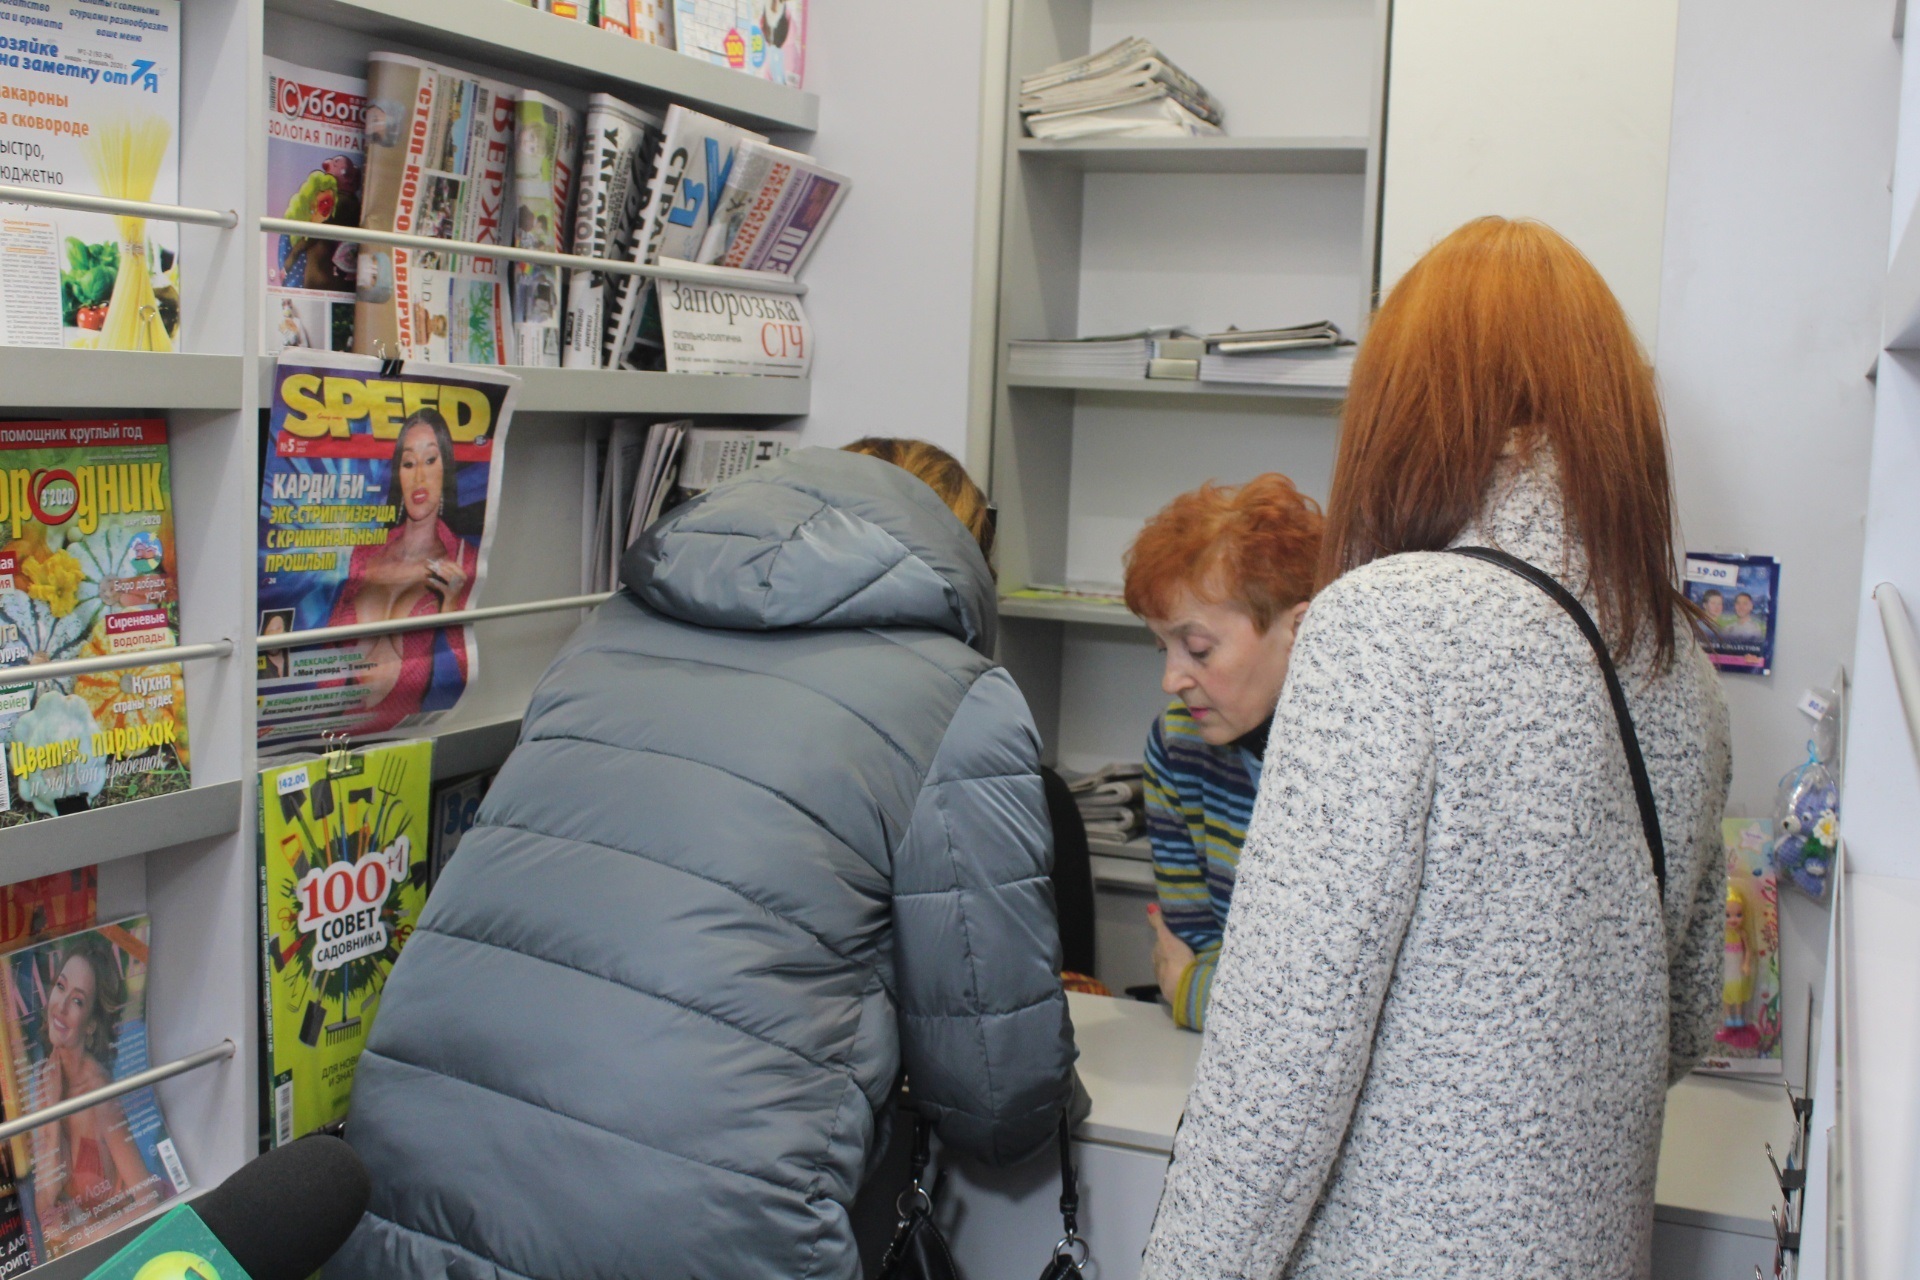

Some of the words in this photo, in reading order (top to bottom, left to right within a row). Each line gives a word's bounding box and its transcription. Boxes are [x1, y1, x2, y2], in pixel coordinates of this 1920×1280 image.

[119, 2, 160, 16] солеными
[20, 15, 63, 29] аромата
[70, 9, 108, 21] огурцами
[110, 16, 168, 32] разнообразят
[96, 28, 118, 38] ваше
[119, 32, 142, 42] меню
[22, 56, 99, 84] заметку
[103, 70, 128, 85] от
[0, 86, 68, 108] акароны
[12, 114, 89, 138] сковороде
[269, 119, 320, 143] ЗОЛОТАЯ
[671, 281, 800, 325] Запорозька
[762, 322, 804, 358] СІЧ
[1, 427, 67, 443] помощник
[70, 423, 119, 443] круглый
[123, 426, 143, 440] год
[273, 474, 337, 504] КАРДИ
[338, 474, 365, 505] БИ
[269, 505, 396, 524] ЭКС-СТРИПТИЗЕРША
[266, 530, 276, 549] С
[277, 527, 389, 548] КРИМИНАЛЬНЫМ
[265, 552, 337, 573] ПРОШЛЫМ
[1697, 567, 1727, 578] 19.00
[114, 580, 134, 592] Бюро
[136, 578, 165, 591] добрых
[145, 588, 167, 602] услуг
[108, 612, 165, 631] Сиреневые
[113, 633, 166, 648] водопады
[294, 656, 338, 668] АЛЕКСАНДР
[315, 665, 340, 677] рекорд
[132, 674, 171, 695] Кухня
[113, 701, 145, 714] страны
[147, 694, 173, 711] чудес
[91, 720, 177, 760] пирожок
[105, 752, 166, 787] гребешок
[303, 861, 386, 922] 100
[321, 907, 375, 942] СОВЕТ
[317, 931, 382, 962] САДОВНИКА
[321, 1063, 338, 1080] ДЛЯ
[85, 1179, 112, 1202] Лоза
[94, 1193, 125, 1217] роковой
